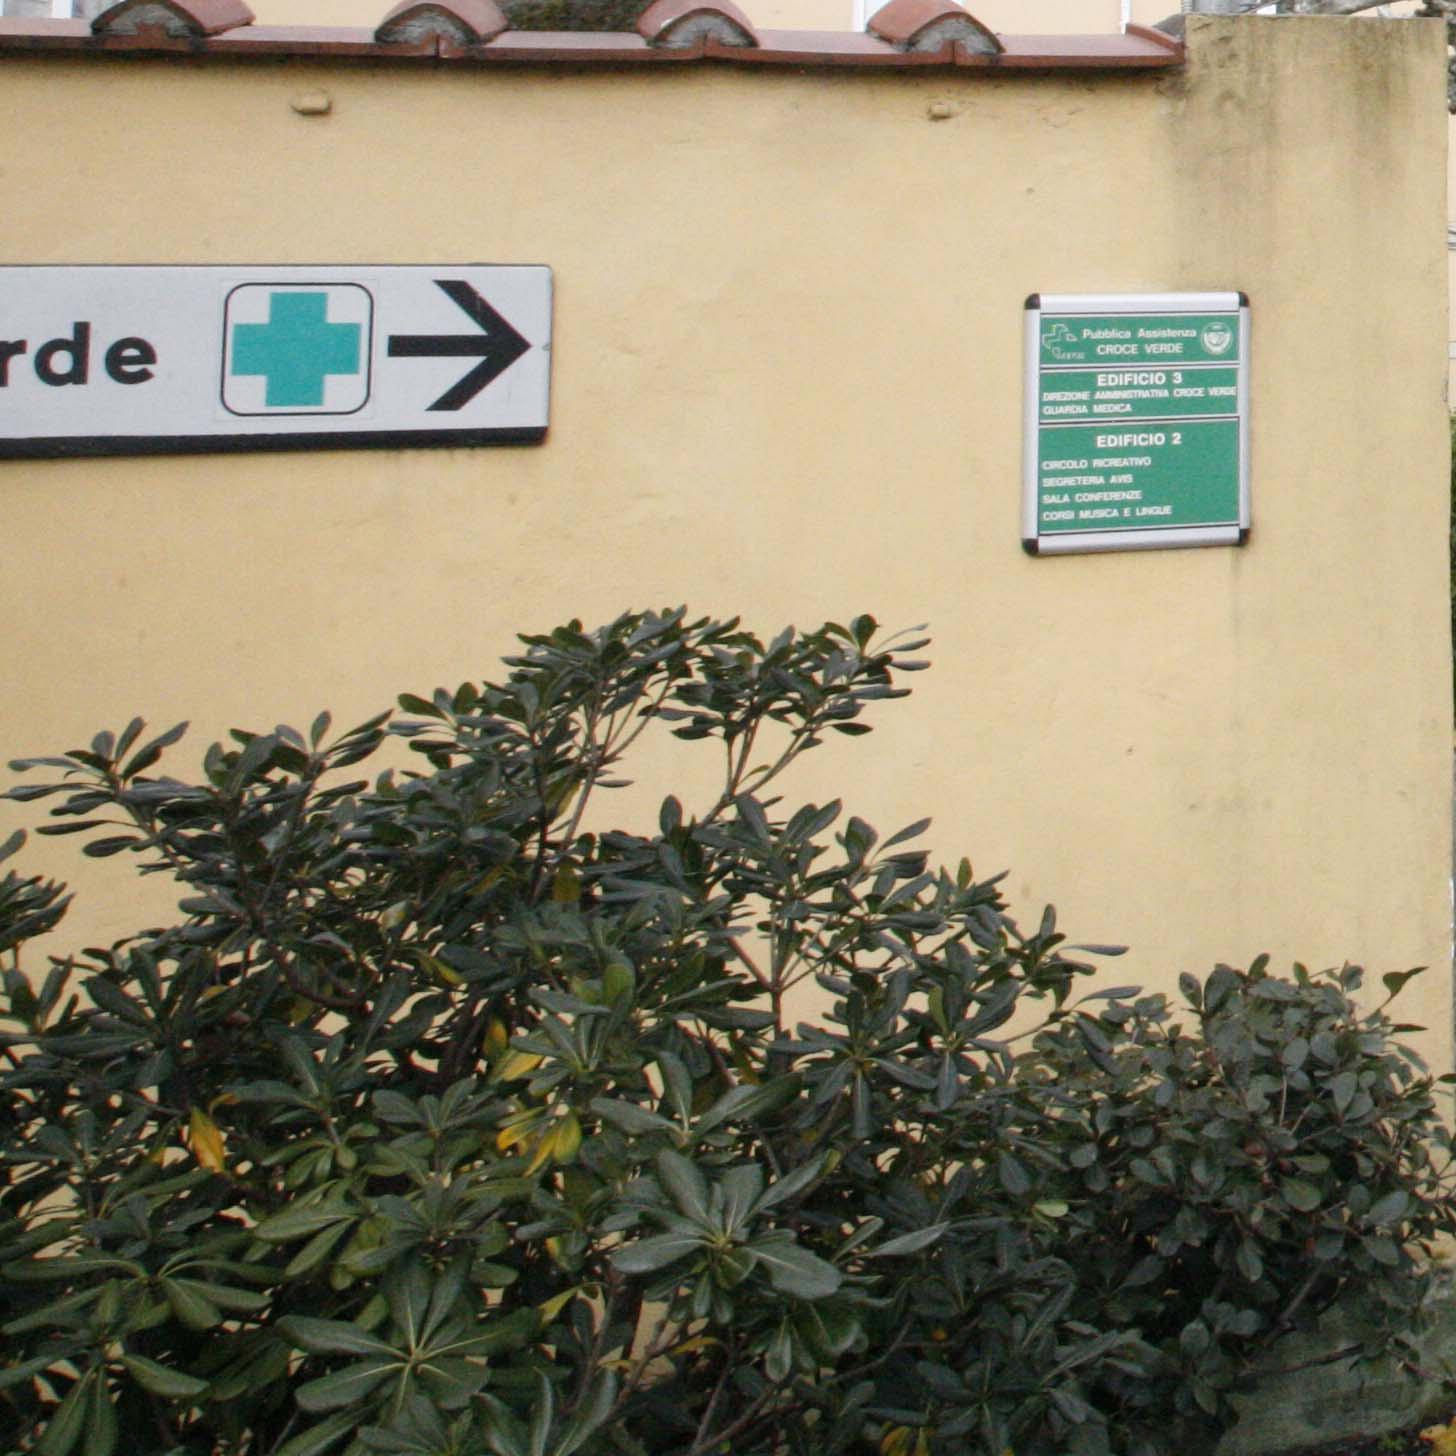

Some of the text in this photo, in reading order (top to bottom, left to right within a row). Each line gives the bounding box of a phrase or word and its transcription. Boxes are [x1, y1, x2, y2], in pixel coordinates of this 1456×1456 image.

[1082, 327, 1197, 340] Pubblica Assistenza
[1097, 344, 1139, 355] CROCE
[1145, 343, 1184, 354] VERDE
[1096, 371, 1183, 386] EDIFICIO 3
[1042, 391, 1091, 402] DIREZIONE
[1173, 387, 1205, 397] CROCE
[1208, 386, 1237, 396] VERDE
[1042, 403, 1132, 415] GUARDIA MEDICA
[1096, 431, 1183, 448] EDIFICIO 2
[1042, 456, 1152, 471] CIRCOLO RICREATIVO
[1042, 474, 1133, 487] SEGRETERIA AVIS
[1042, 490, 1143, 504] SALA CONFERENZE
[1043, 505, 1172, 521] CORSI MUSICA E LINGUE
